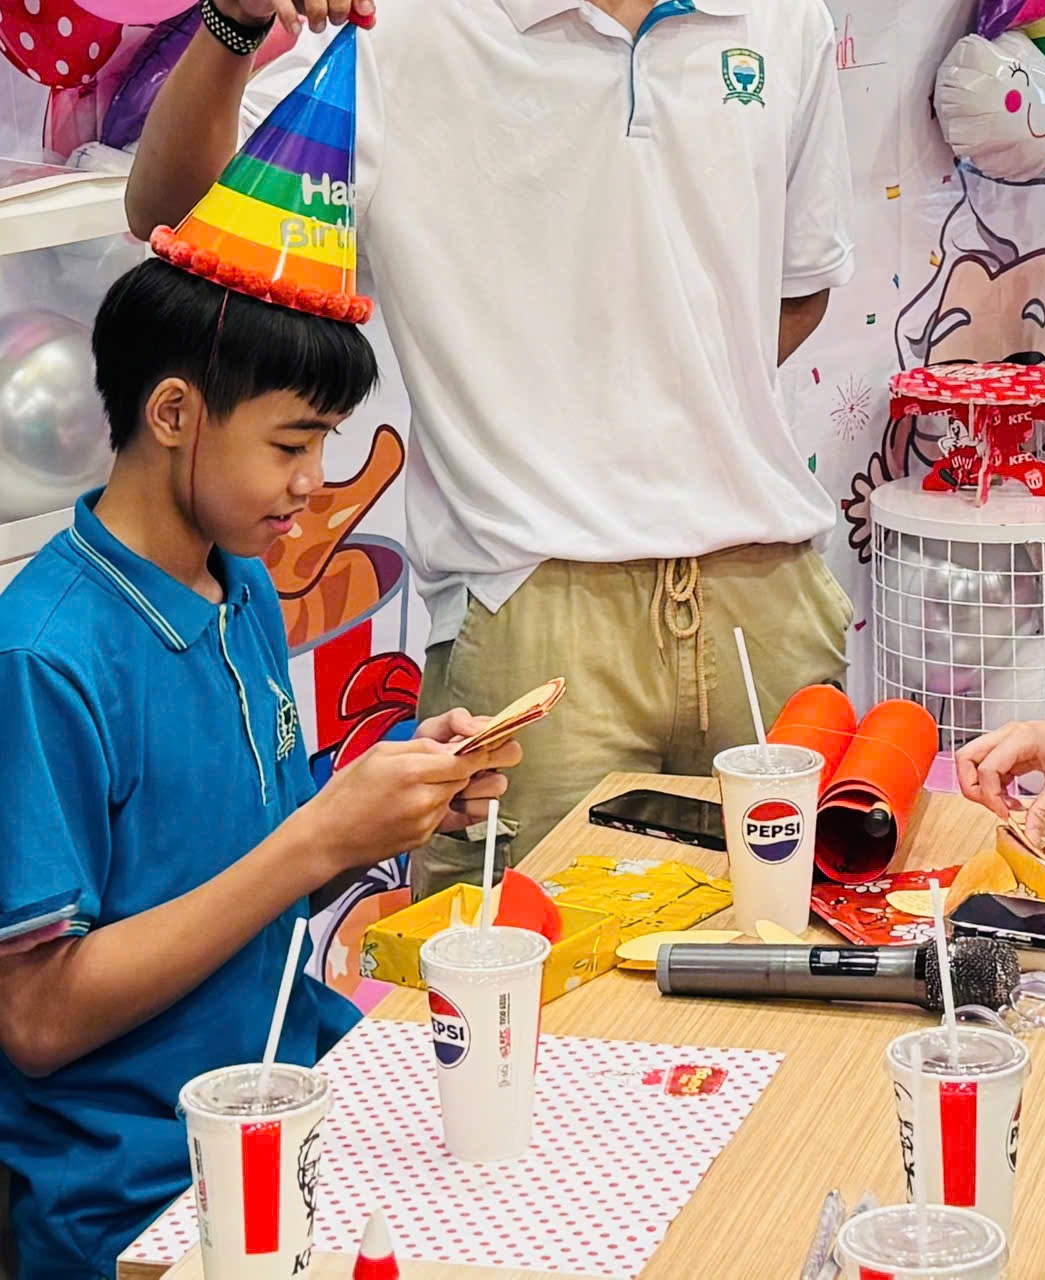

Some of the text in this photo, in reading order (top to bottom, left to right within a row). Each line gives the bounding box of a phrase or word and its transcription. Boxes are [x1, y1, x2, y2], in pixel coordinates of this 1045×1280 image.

[1008, 411, 1033, 425] KFC
[1008, 452, 1034, 466] KFC
[746, 822, 800, 838] PEPSI
